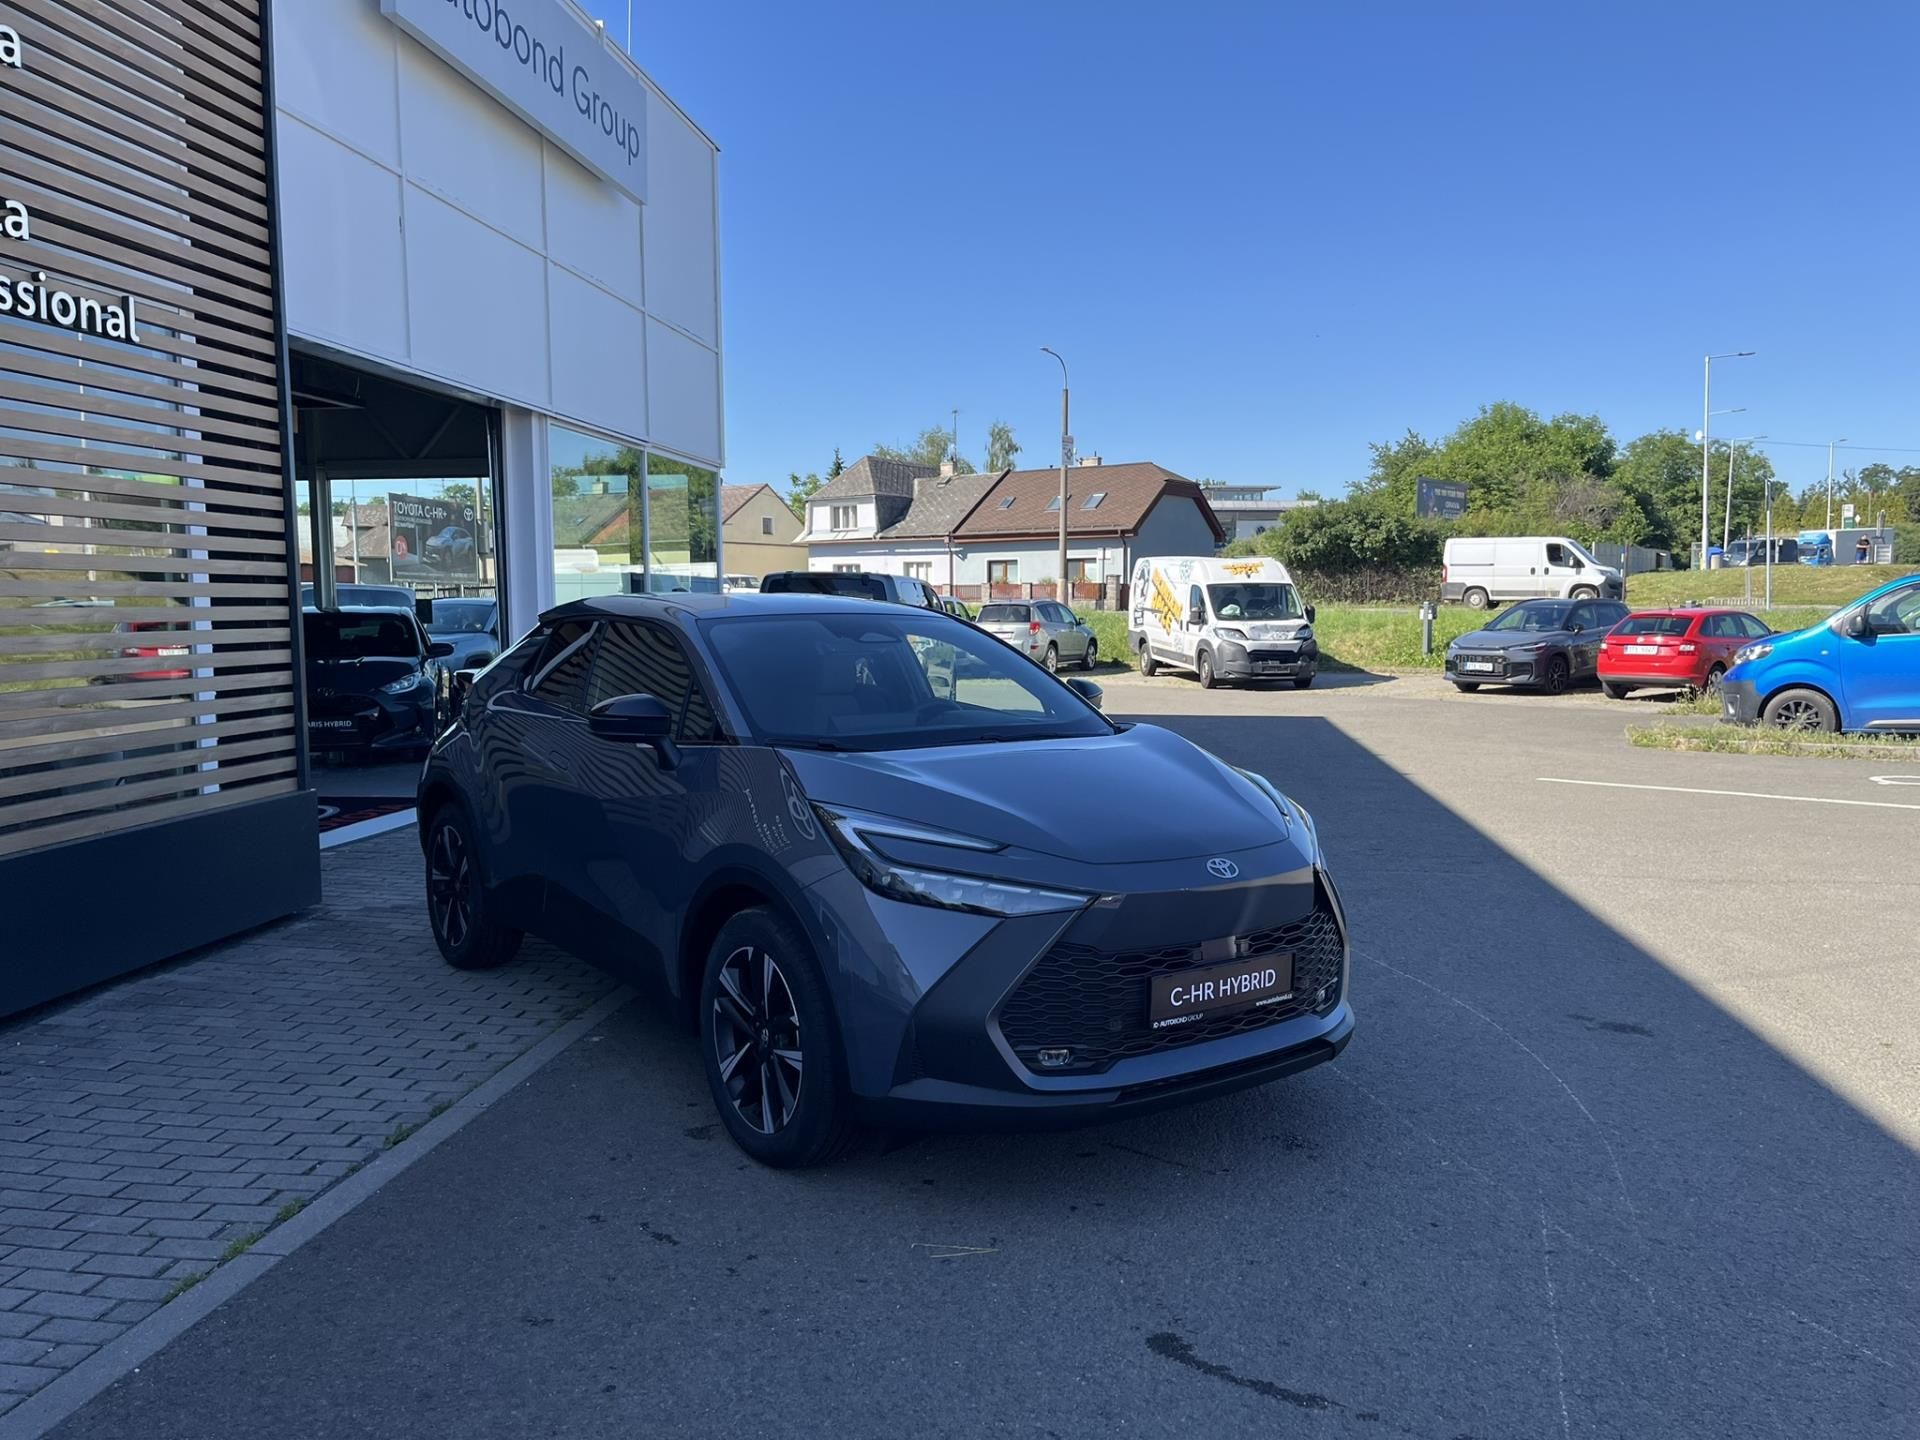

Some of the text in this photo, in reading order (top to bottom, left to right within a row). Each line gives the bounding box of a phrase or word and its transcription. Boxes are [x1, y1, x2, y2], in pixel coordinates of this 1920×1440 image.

[572, 65, 640, 166] Group
[0, 199, 30, 241] a
[393, 500, 448, 520] TOYOTA C-HR+
[323, 719, 352, 728] HYBRID
[1170, 968, 1276, 1007] C-HR HYBRID
